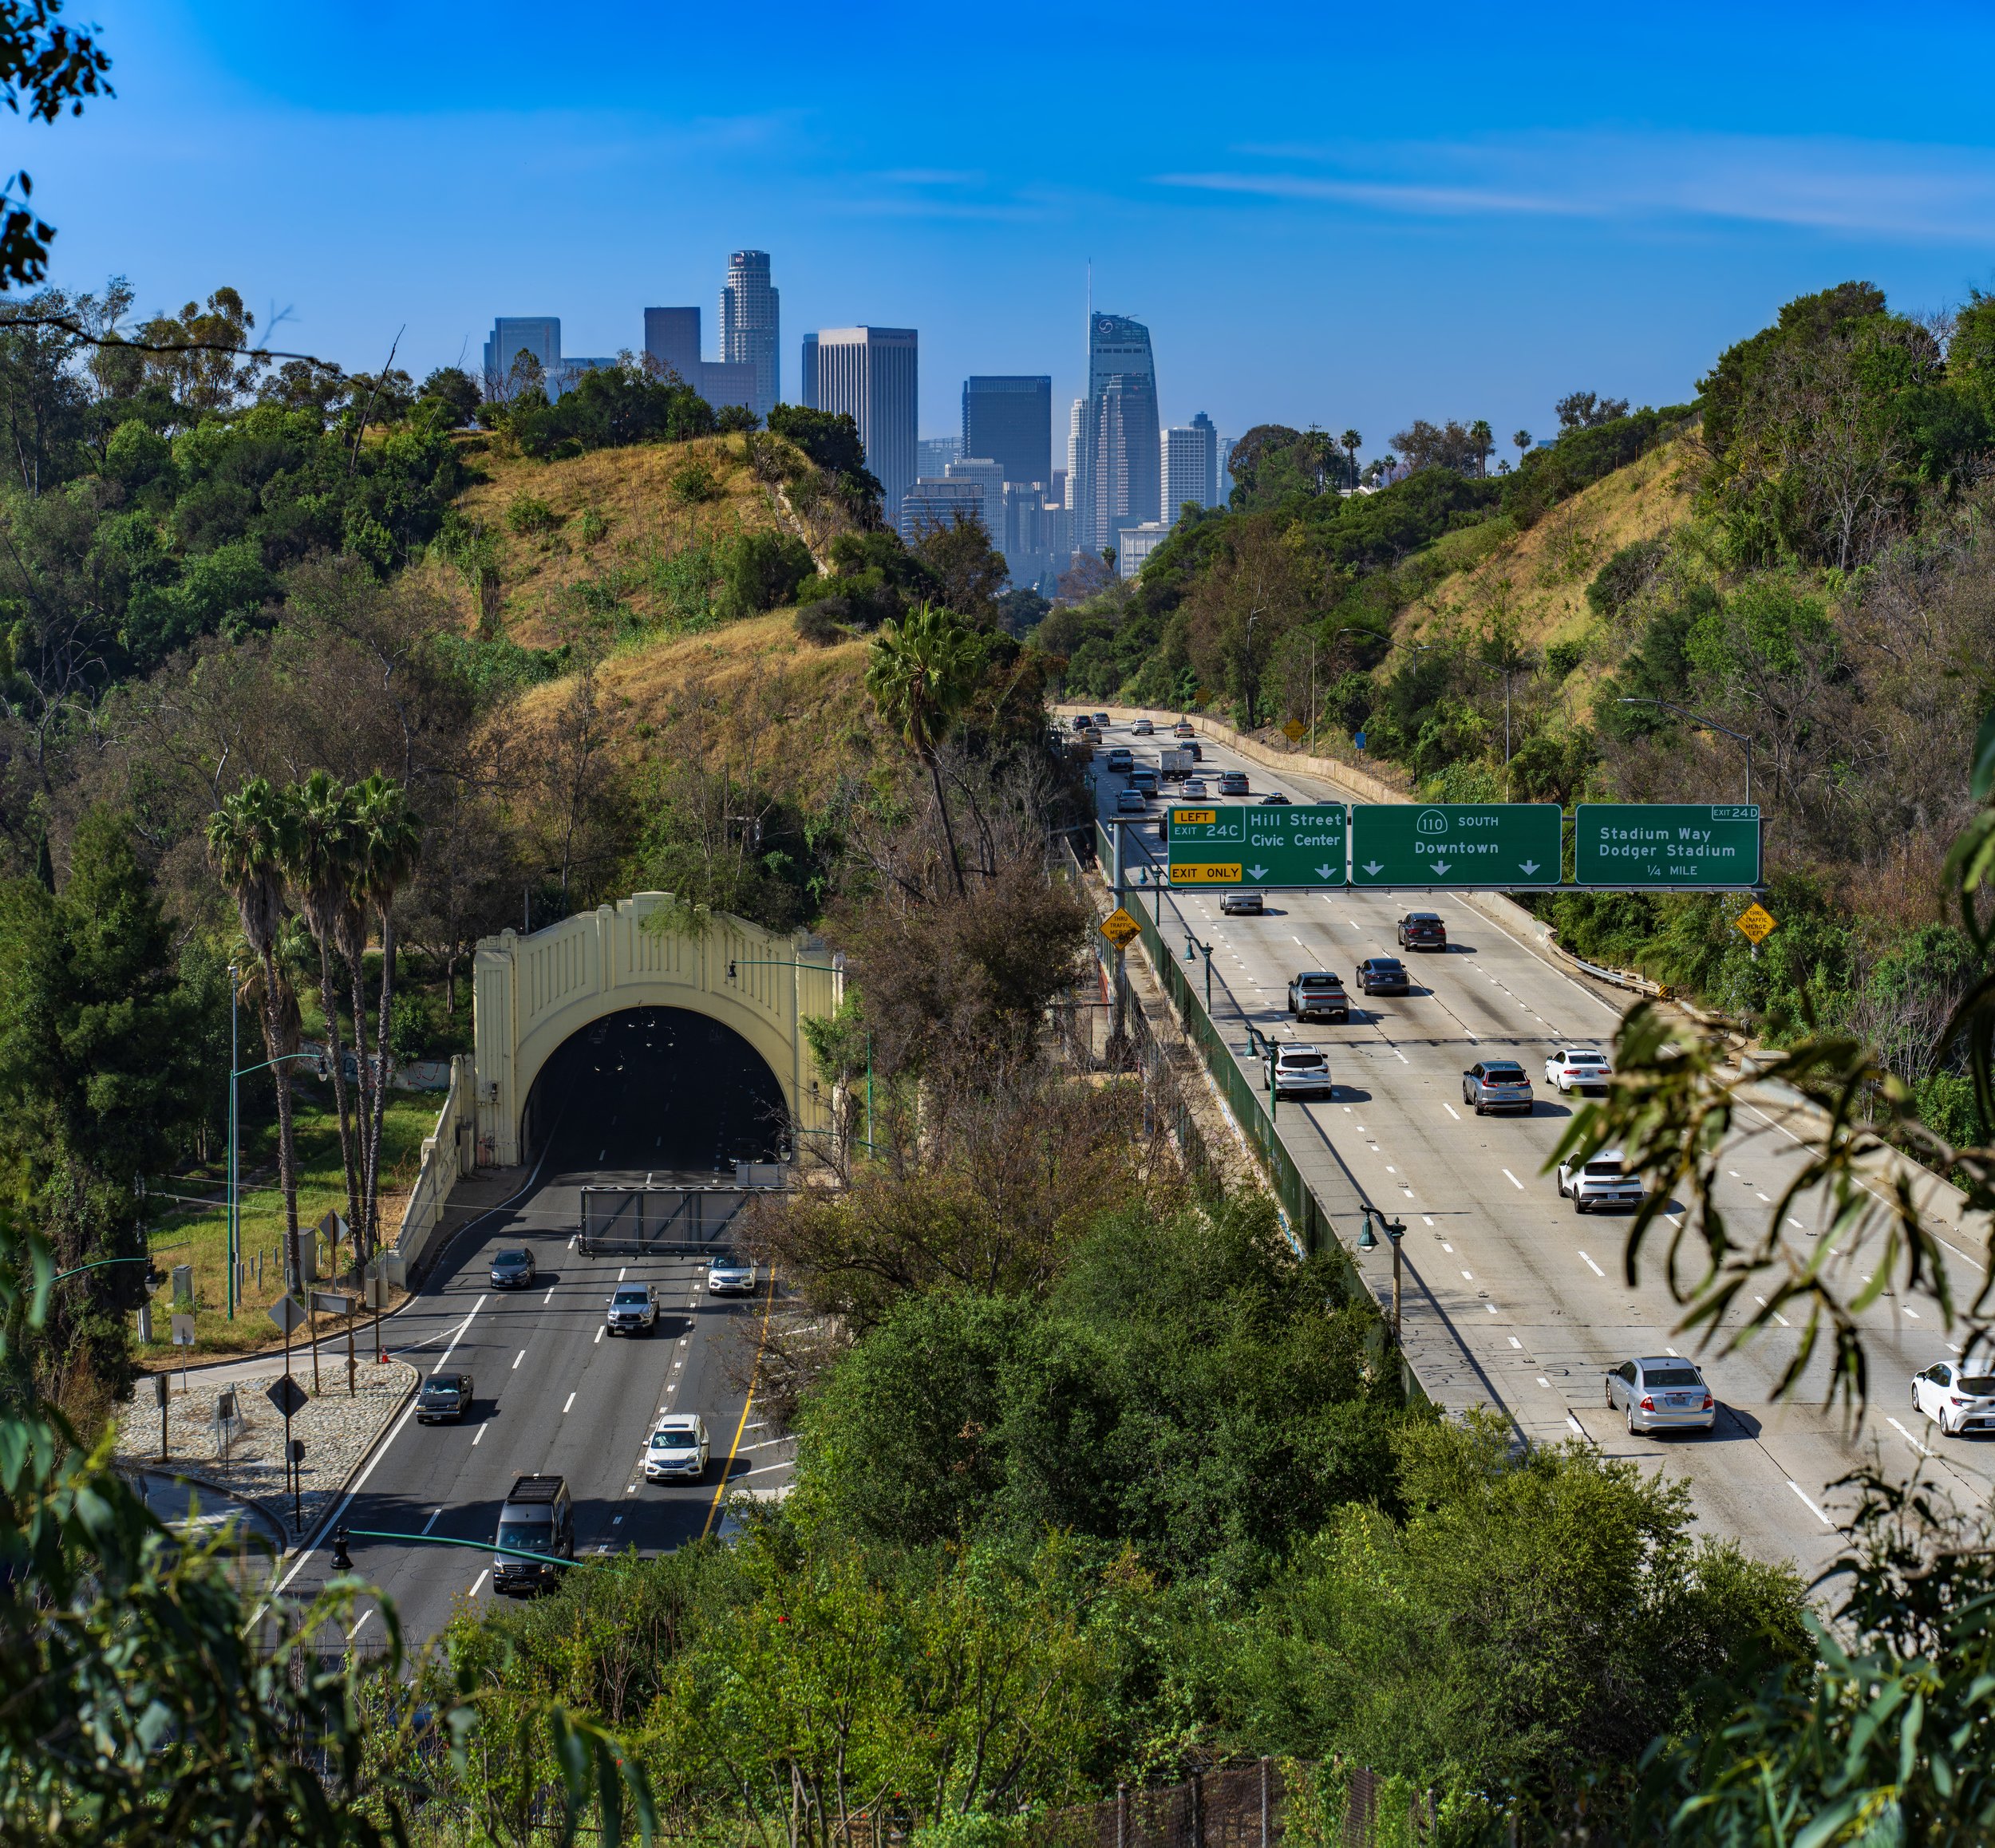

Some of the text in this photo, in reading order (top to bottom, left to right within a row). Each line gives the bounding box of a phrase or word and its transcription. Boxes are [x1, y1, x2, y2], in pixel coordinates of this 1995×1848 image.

[1180, 812, 1209, 822] LEFT
[1732, 808, 1758, 817] 24D
[1250, 814, 1341, 826] Hill Street
[1423, 816, 1499, 831] 110 SOUTH
[1175, 824, 1238, 836] EXIT 24C
[1600, 827, 1711, 843] Stadium Way
[1251, 834, 1341, 847] Civic Center
[1415, 841, 1499, 854] Downtown
[1599, 844, 1736, 860] Dodger Stadium
[1172, 867, 1239, 878] EXIT ONLY
[1669, 866, 1697, 875] MILE
